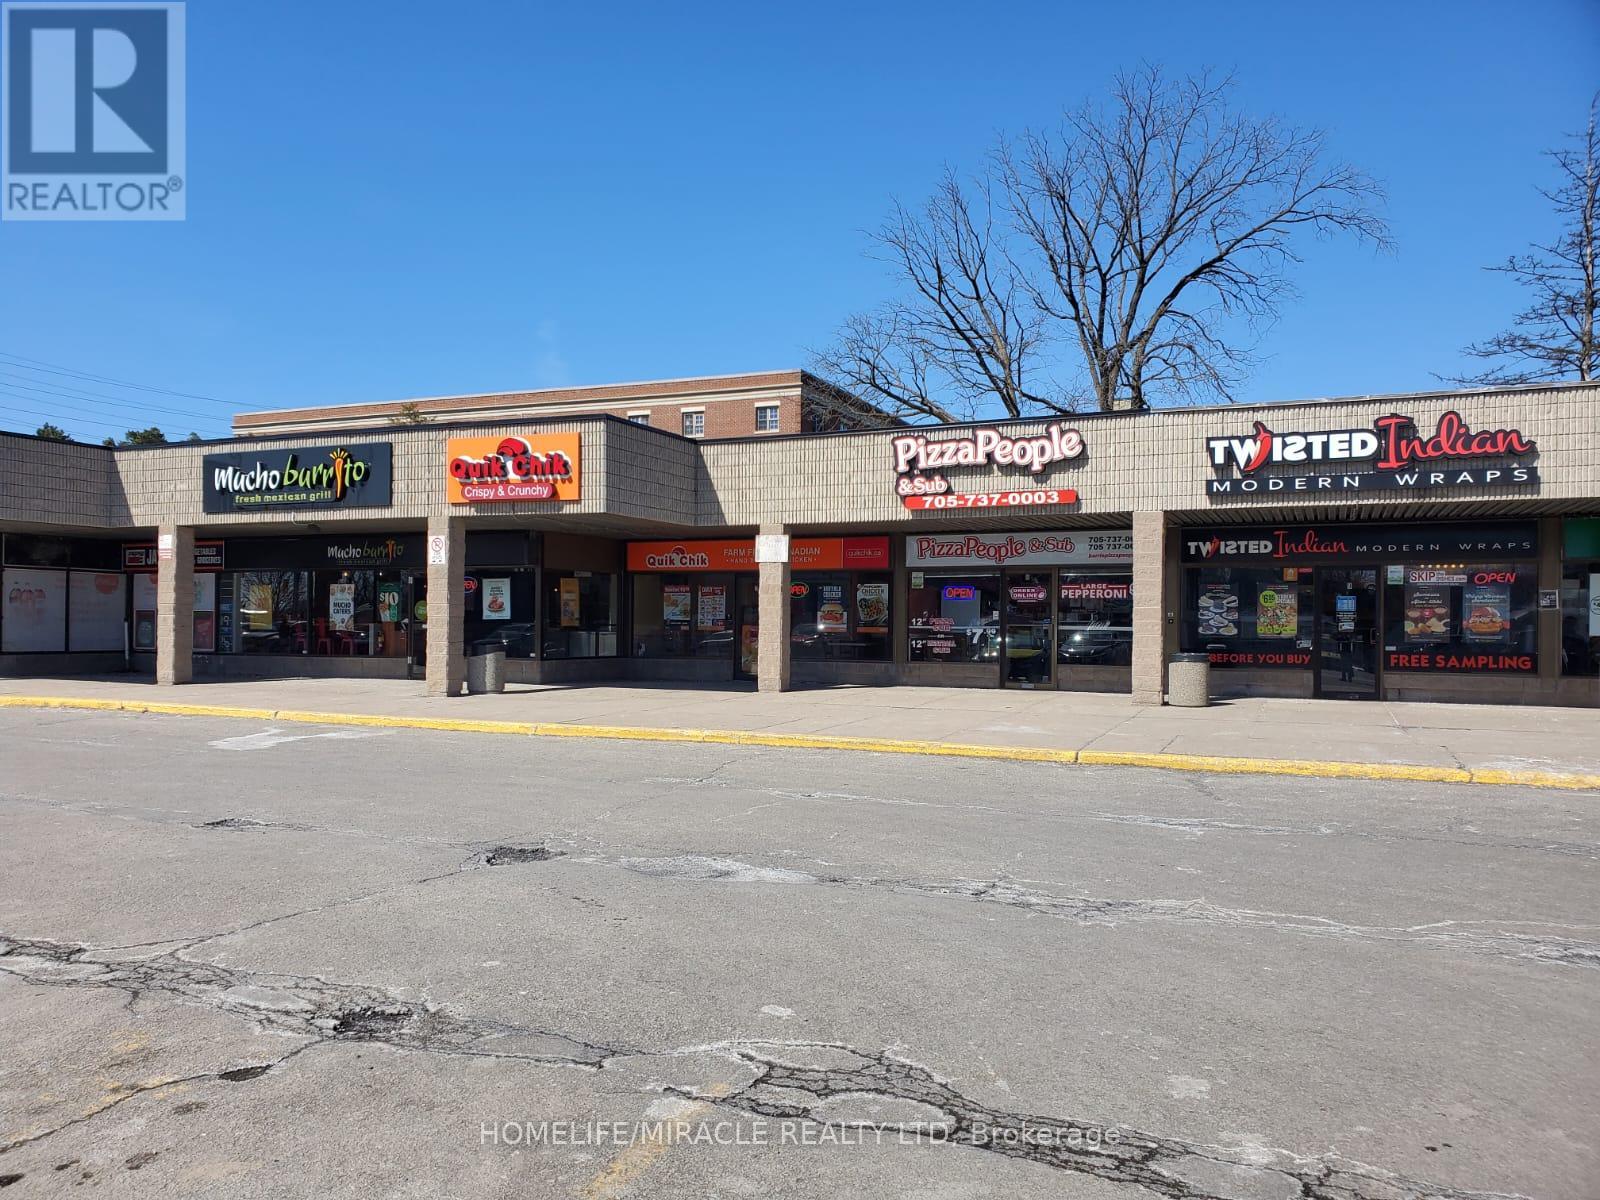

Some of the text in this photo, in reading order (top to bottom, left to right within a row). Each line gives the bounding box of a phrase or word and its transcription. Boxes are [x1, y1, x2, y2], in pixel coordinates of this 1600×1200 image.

[893, 424, 1083, 472] PizzaPeople
[1209, 413, 1530, 471] TWISTED Indian
[450, 453, 567, 479] Quik Chik
[283, 450, 366, 498] burrito
[1212, 469, 1529, 493] MODERN WRAPS
[235, 490, 332, 504] fresh mexican grill
[464, 485, 549, 498] Crispy & Crunchy
[921, 491, 1060, 508] 705-737-0003
[1088, 536, 1133, 544] 705-737-0
[1187, 530, 1531, 558] TWISTED Indian MODERN WRAPS
[724, 548, 746, 557] FARM
[916, 535, 1026, 563] PizzaPeople
[646, 552, 708, 567] Quik Chik
[1410, 571, 1436, 582] SKIP
[1473, 572, 1517, 585] OPEN
[379, 592, 398, 606] $10
[946, 587, 975, 599] OPEN
[1060, 589, 1128, 599] PEPPERONI
[911, 617, 927, 626] 12"
[911, 640, 927, 648] 12"
[1208, 653, 1312, 665] BEFORE YOU BUY
[1390, 654, 1532, 670] FREE SAMPLING
